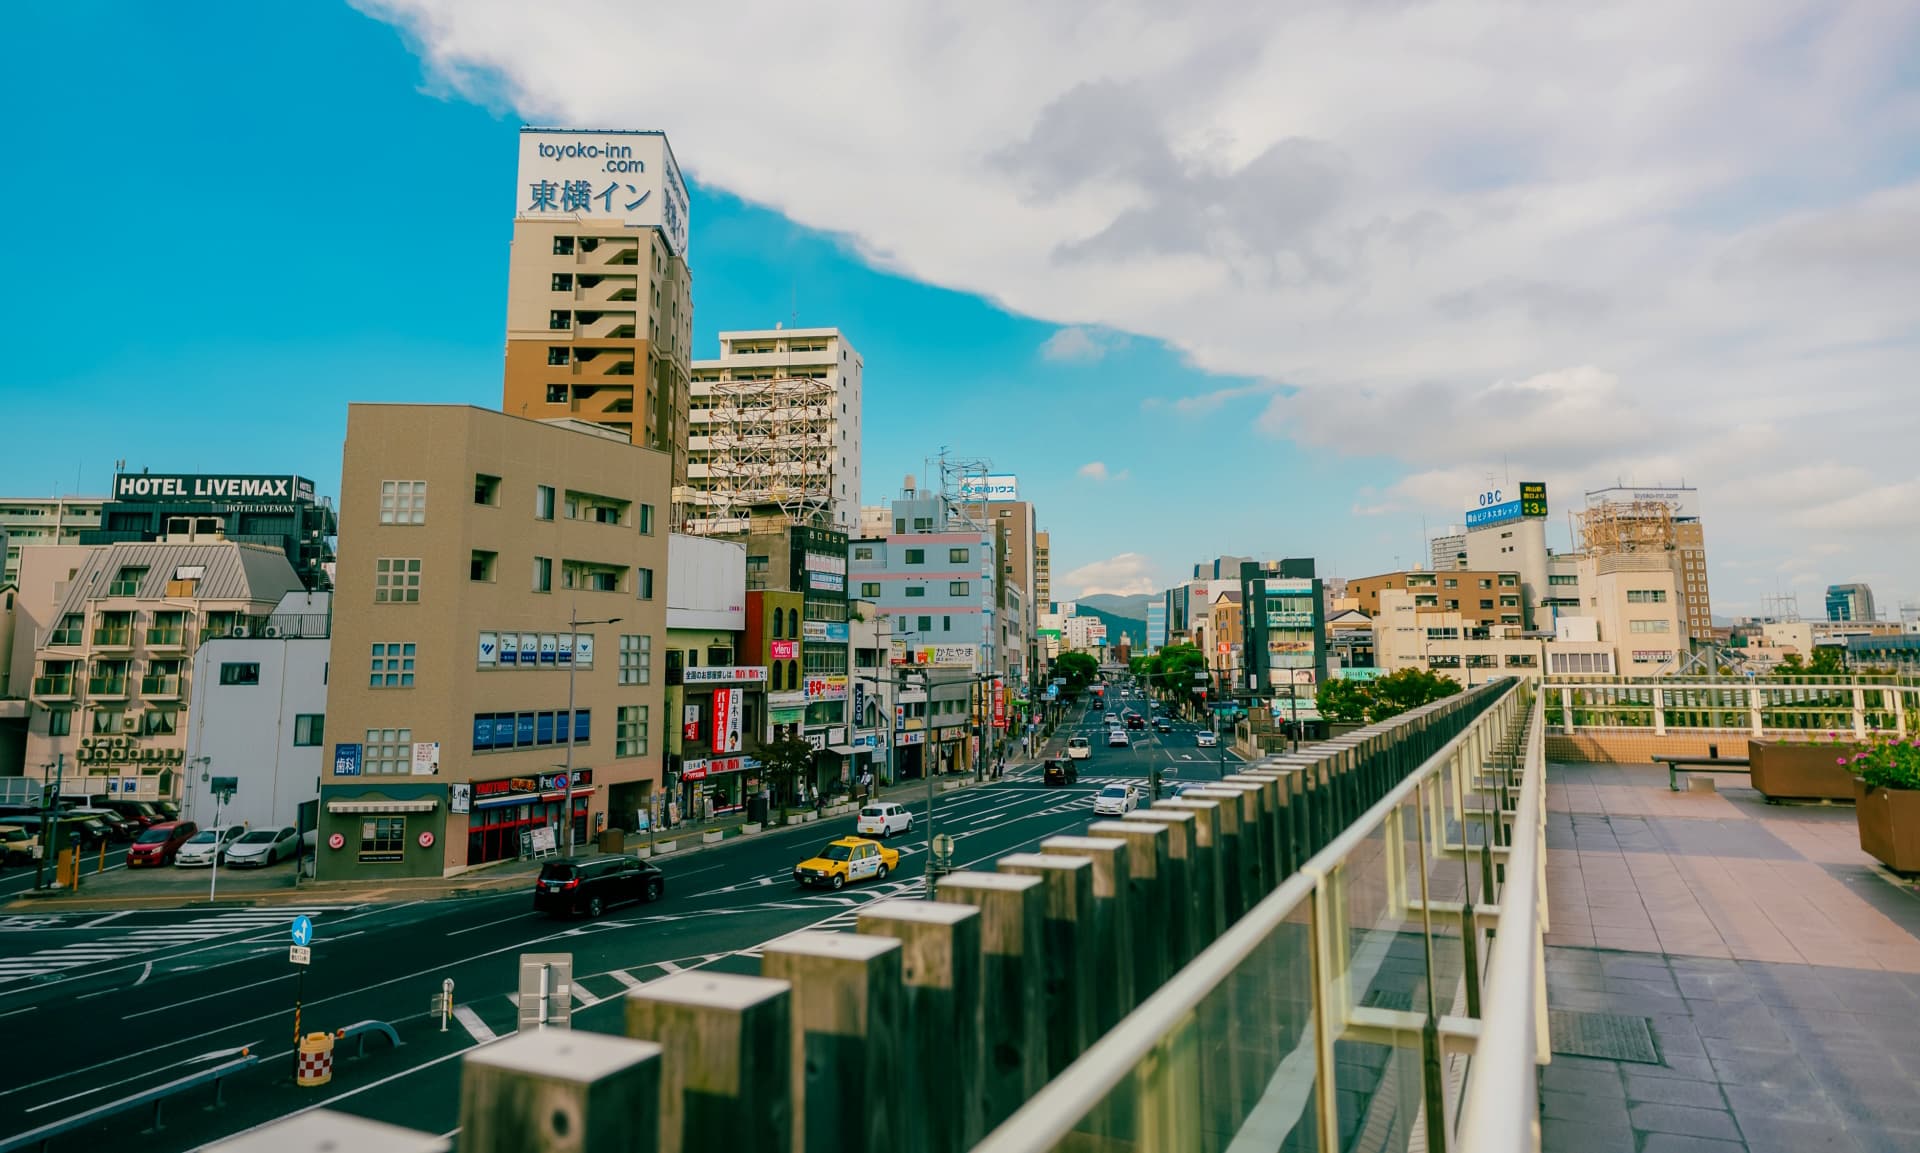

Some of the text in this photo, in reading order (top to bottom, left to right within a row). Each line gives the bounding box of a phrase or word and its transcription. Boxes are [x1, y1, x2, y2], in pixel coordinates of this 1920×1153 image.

[538, 142, 632, 161] toyoko-inn
[601, 159, 644, 173] .com
[528, 180, 651, 212] 東横イン
[119, 478, 187, 495] HOTEL
[1480, 490, 1501, 506] OBC
[226, 504, 255, 513] HOTEL
[1530, 502, 1539, 513] 3
[936, 648, 974, 657] かたやま
[731, 690, 739, 730] 白木屋
[855, 688, 863, 721] SONY
